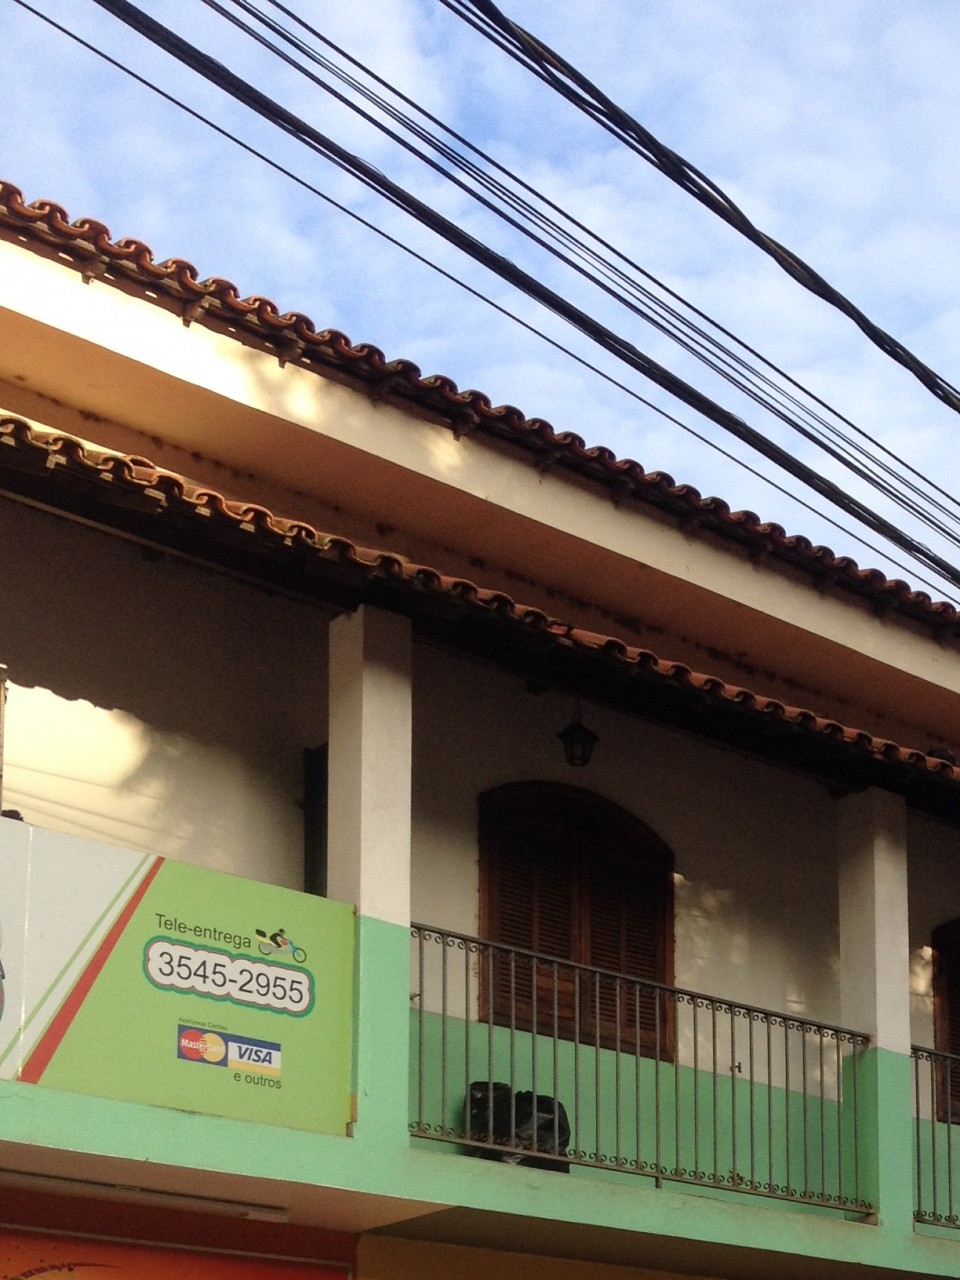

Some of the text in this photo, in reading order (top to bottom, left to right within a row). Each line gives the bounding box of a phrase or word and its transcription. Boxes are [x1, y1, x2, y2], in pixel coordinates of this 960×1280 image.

[155, 913, 252, 948] Tele-entrega
[158, 951, 304, 1004] 3545-2955
[237, 1045, 273, 1065] VISA
[234, 1073, 282, 1089] e outros
